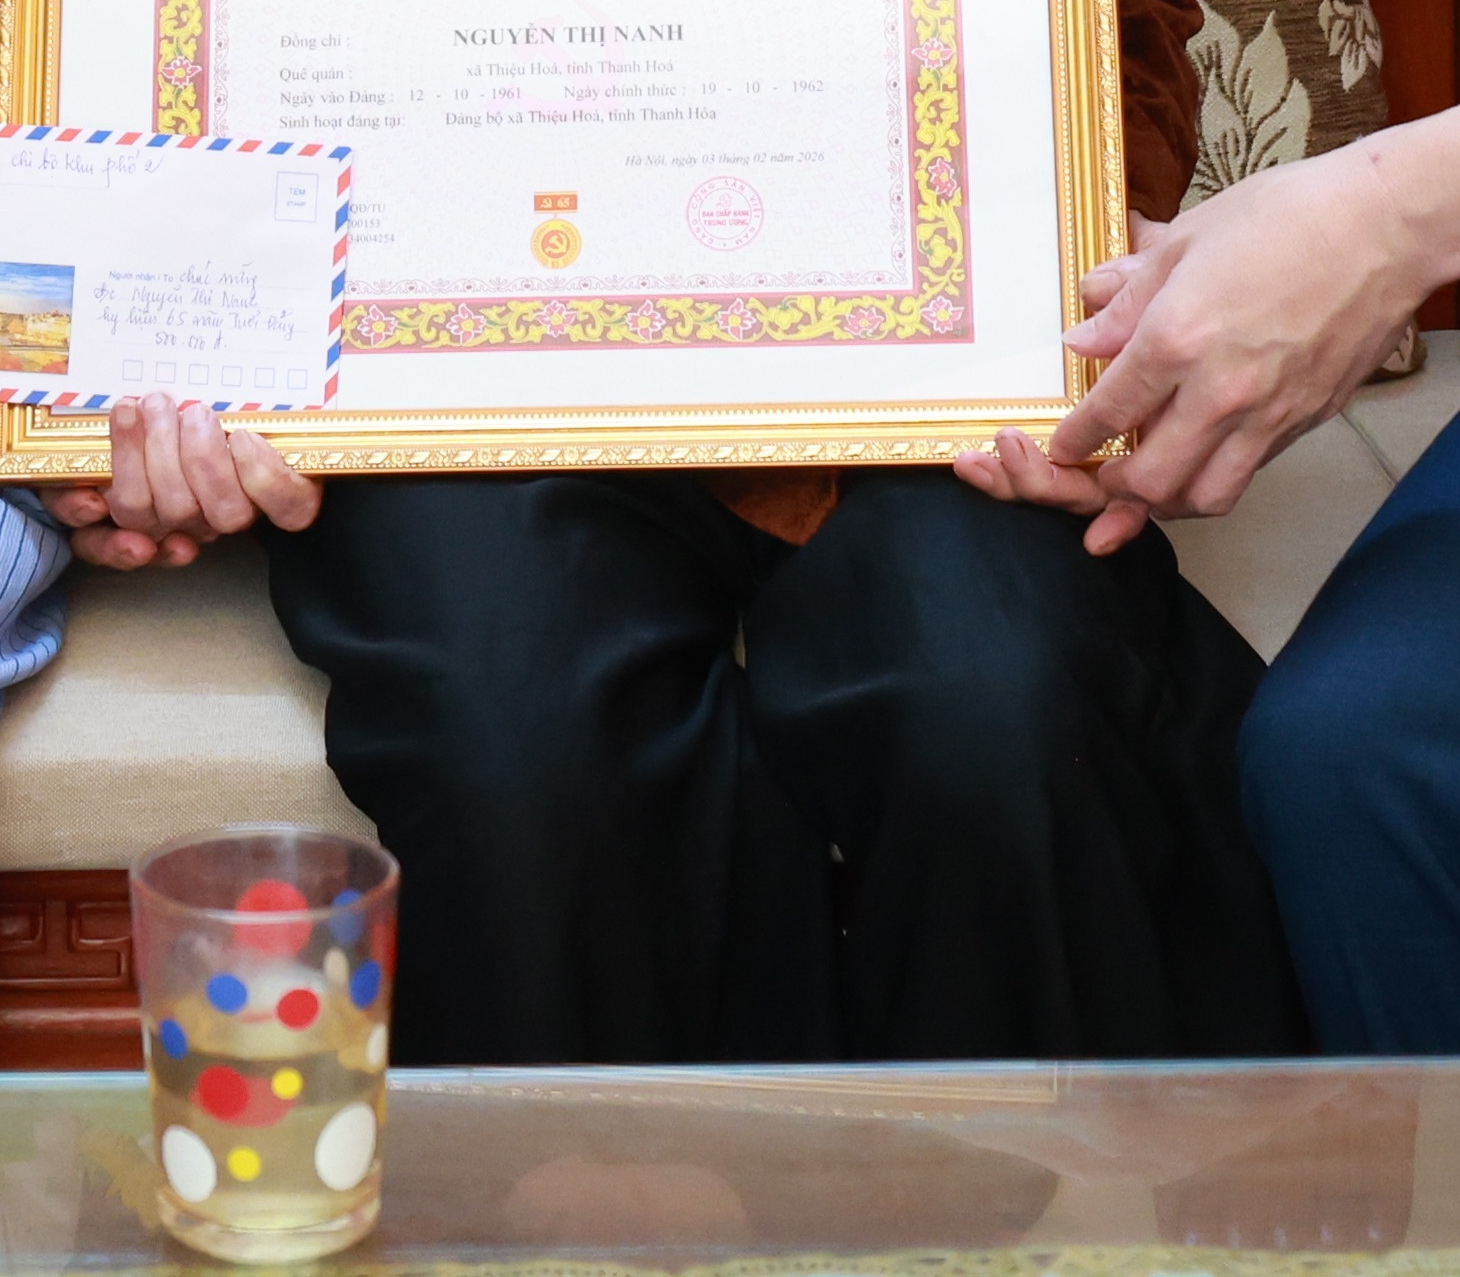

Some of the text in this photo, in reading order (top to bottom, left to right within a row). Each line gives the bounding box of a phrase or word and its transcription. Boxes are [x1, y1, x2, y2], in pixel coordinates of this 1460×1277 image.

[280, 32, 317, 50] Đồng
[452, 22, 684, 47] NGUYỄN THỊ NANH
[279, 67, 308, 82] Quê
[465, 63, 481, 77] xã
[486, 61, 525, 79] Thiệu
[597, 60, 640, 75] Thanh
[280, 91, 315, 107] Ngày
[321, 91, 345, 105] vào
[348, 89, 386, 106] Đảng
[409, 88, 424, 102] 12
[453, 88, 469, 101] 10
[491, 87, 522, 101] 1961
[564, 85, 600, 102] Ngày
[605, 83, 643, 98] chính
[647, 82, 677, 97] thức
[701, 81, 717, 95] 19
[744, 81, 761, 95] 10
[791, 80, 825, 94] 1962
[279, 114, 310, 130] Sinh
[313, 114, 343, 131] hoạt
[445, 111, 483, 127] Đảng
[486, 109, 503, 127] bộ
[507, 110, 524, 124] xã
[528, 109, 568, 125] Thiệu
[639, 106, 684, 122] Thanh
[624, 151, 825, 169] Hà Nội, ngày 03 tháng 02 năm 2026
[288, 187, 306, 196] TEM
[348, 219, 380, 229] 00153
[166, 308, 189, 327] 65
